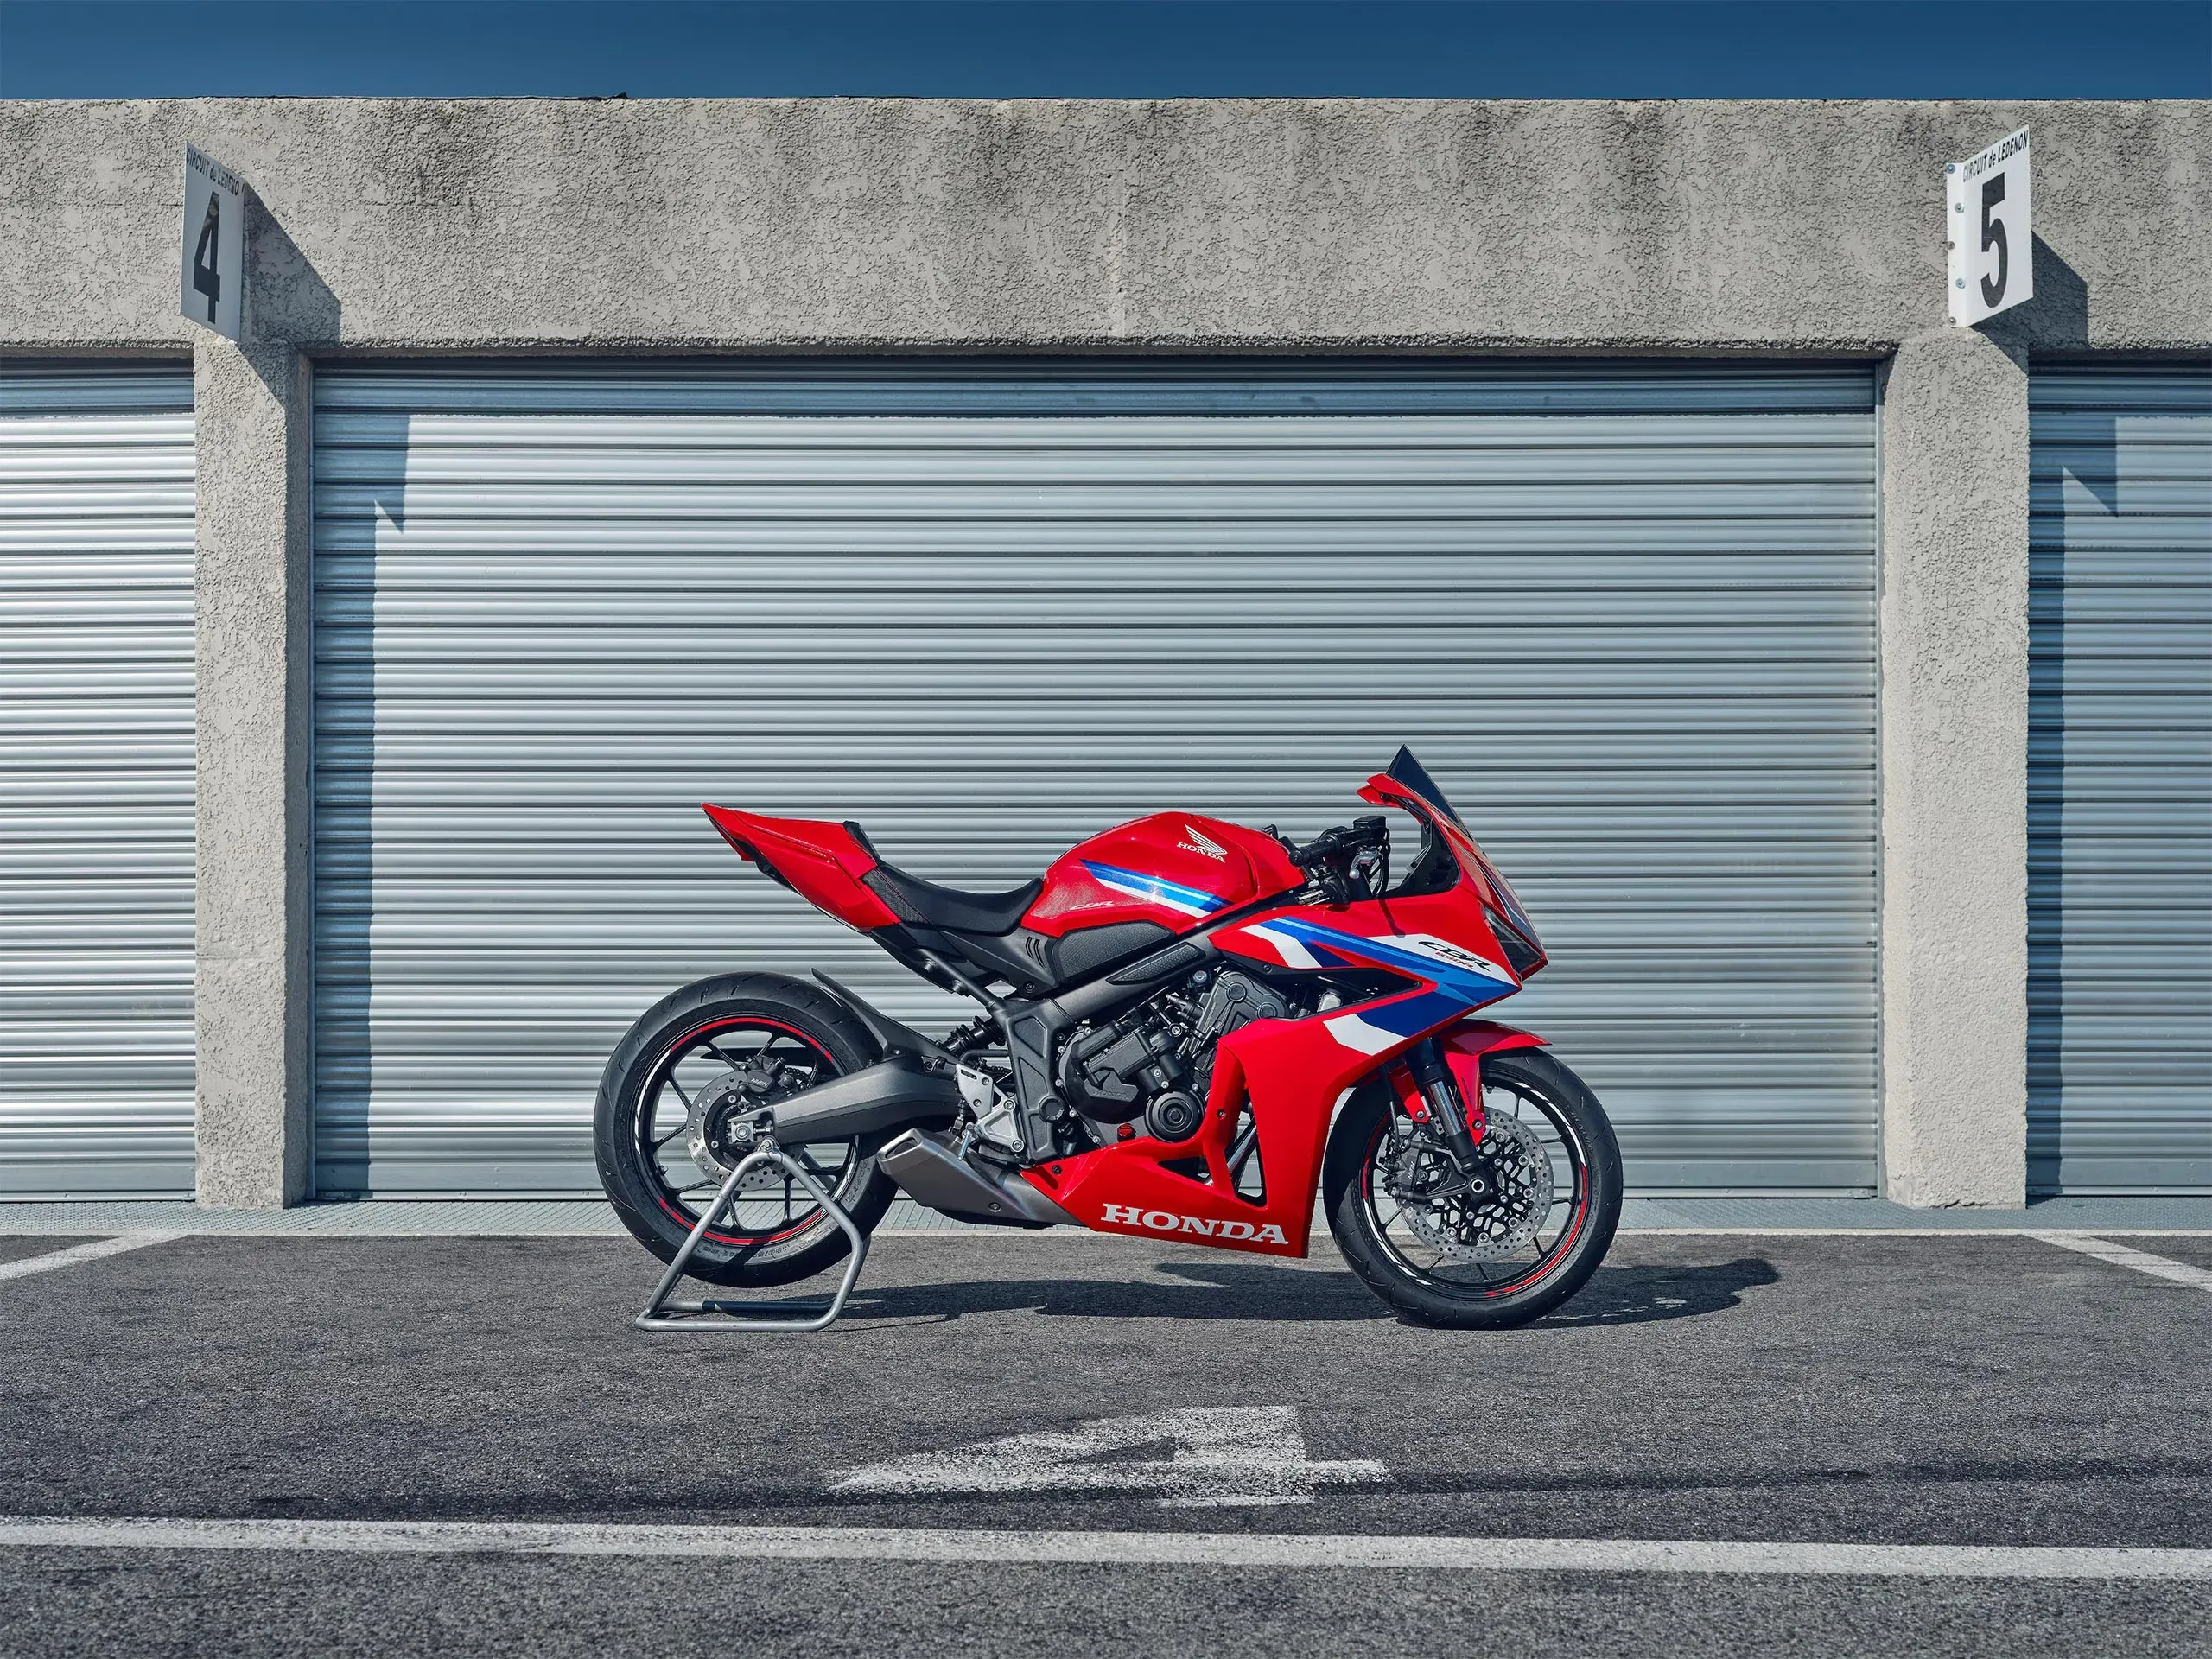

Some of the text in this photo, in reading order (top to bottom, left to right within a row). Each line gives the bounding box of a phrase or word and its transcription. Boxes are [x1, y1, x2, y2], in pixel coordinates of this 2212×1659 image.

[186, 148, 210, 177] CIRCUIT
[209, 164, 217, 182] de
[1963, 130, 2029, 183] CIRCUIT de LEDENON
[193, 190, 221, 325] 4
[1980, 171, 2009, 308] 5
[1176, 841, 1226, 864] HONDA
[1418, 940, 1491, 973] CBR
[1100, 1202, 1289, 1246] HONDA
